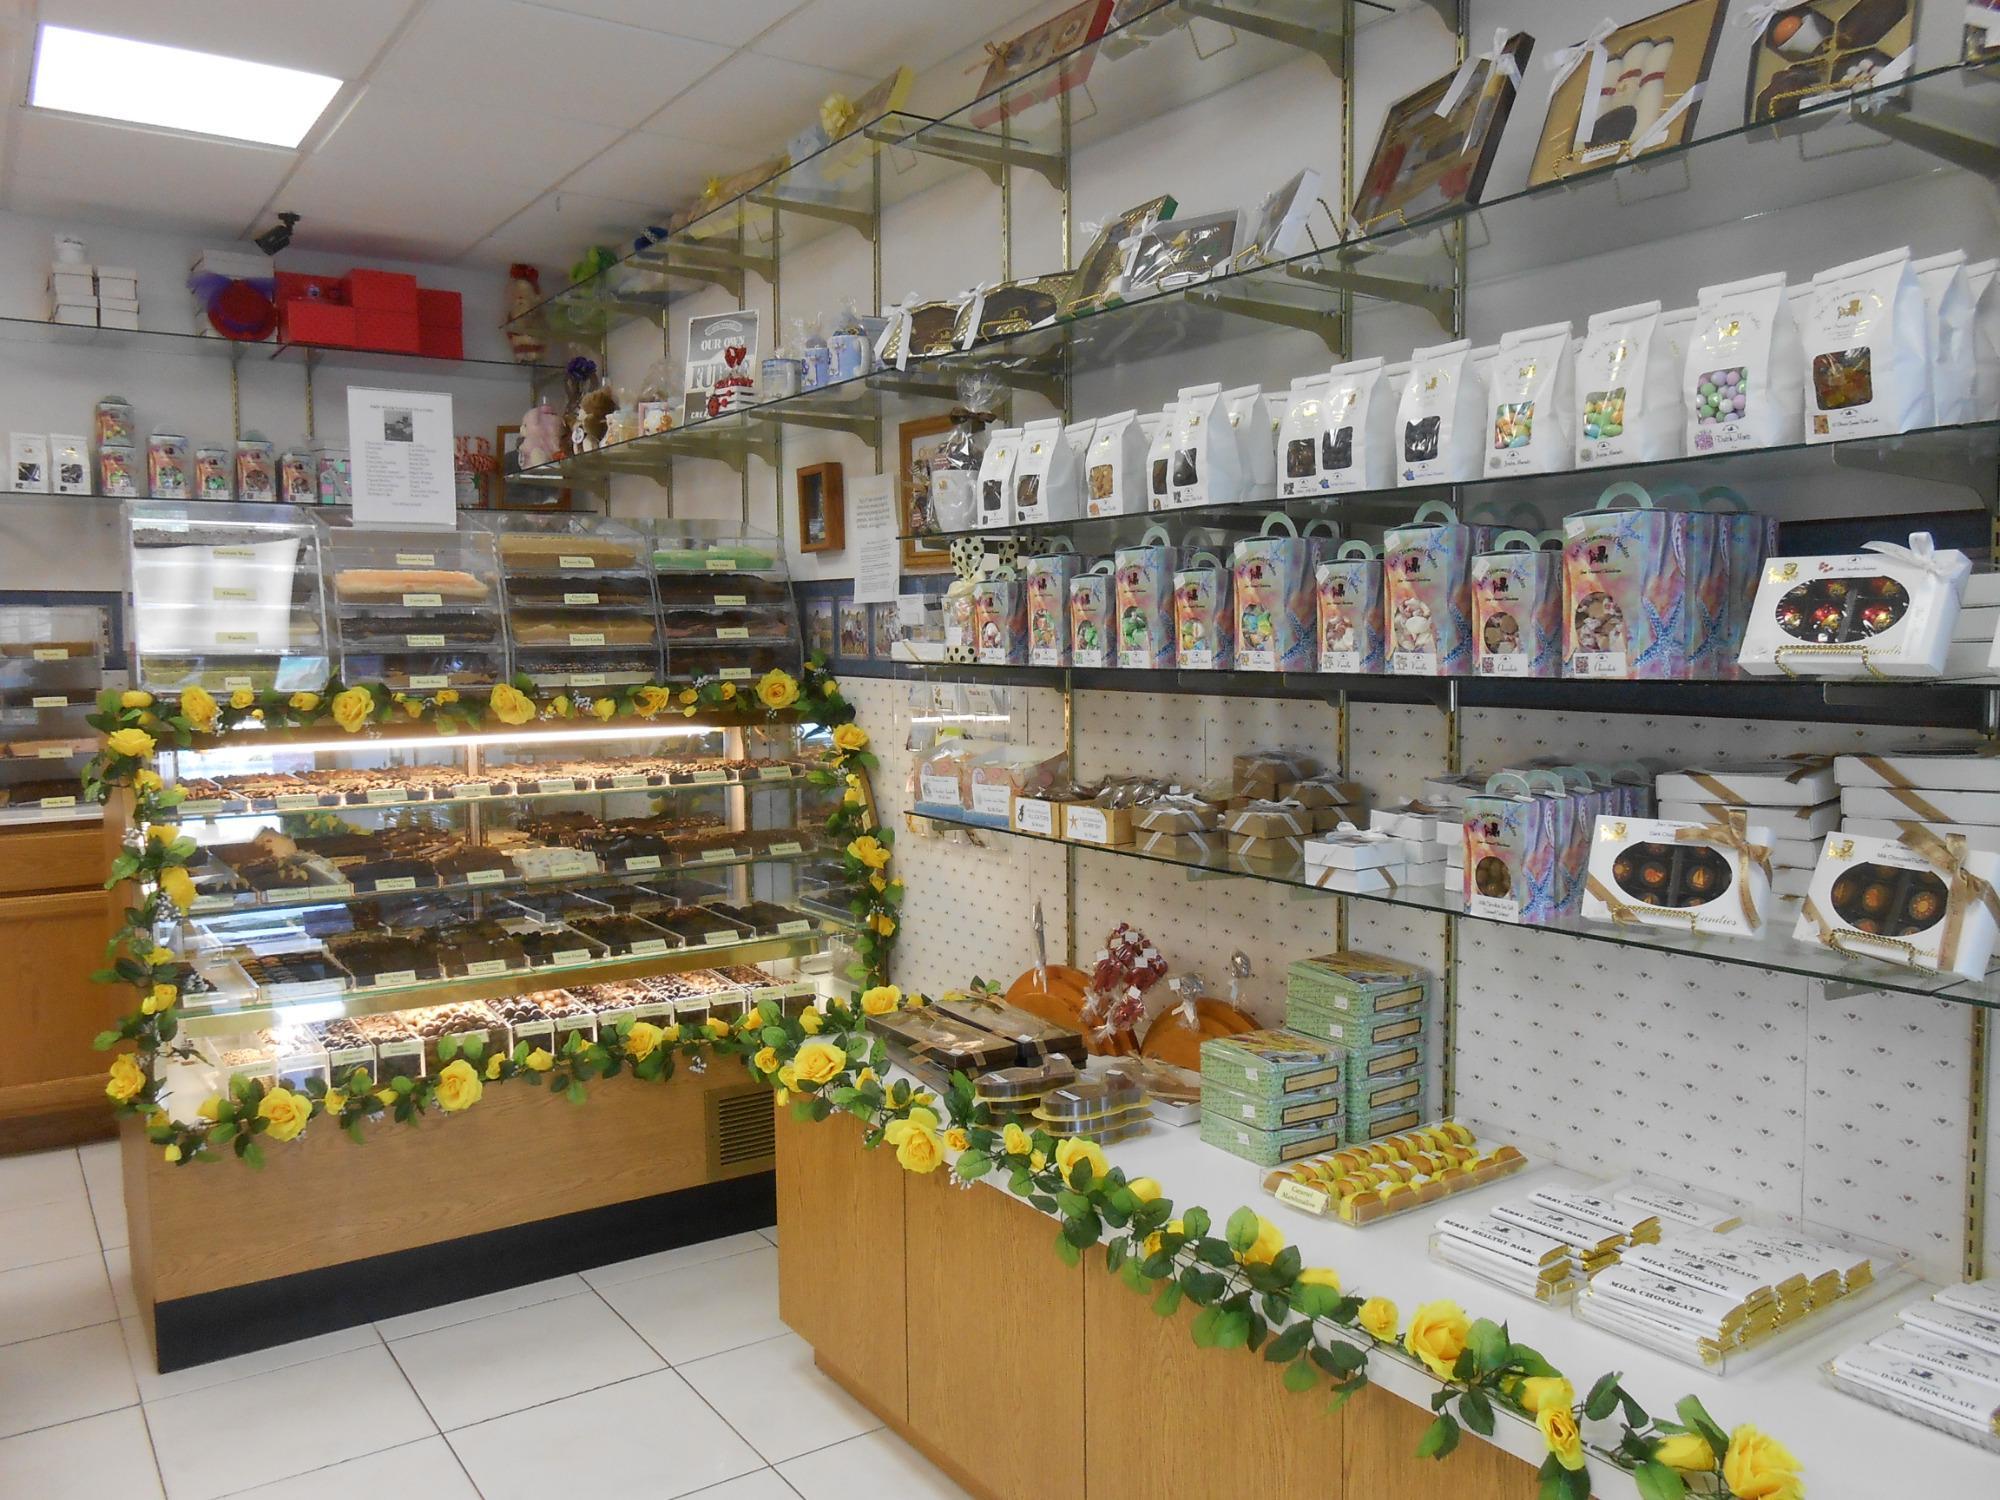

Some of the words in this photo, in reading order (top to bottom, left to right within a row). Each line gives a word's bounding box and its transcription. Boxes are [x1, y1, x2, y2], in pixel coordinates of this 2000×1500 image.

[700, 339, 721, 351] OUR
[724, 335, 745, 348] OWN
[1536, 1192, 1562, 1204] BERRY
[1563, 1201, 1601, 1218] HEALTHY
[1647, 1201, 1699, 1221] CHOCOLATE
[1444, 1218, 1470, 1232] BERRY
[1471, 1228, 1509, 1245] HEALTHY
[1498, 1207, 1525, 1219] BERRY
[1526, 1215, 1565, 1232] HEALTHY
[1673, 1248, 1698, 1260] MILK
[1699, 1257, 1761, 1281] CHOCOLATE
[1769, 1246, 1821, 1263] CHOCOLATE
[1641, 1256, 1666, 1269] MILK
[1667, 1265, 1729, 1291] CHOCOLATE
[1610, 1281, 1637, 1294] MILK
[1639, 1290, 1704, 1315] CHOCOLATE
[1979, 1304, 2000, 1314] DAR
[1944, 1322, 1973, 1336] DARK
[1917, 1353, 1945, 1366] DARK
[1880, 1372, 1909, 1389] DARK
[1911, 1382, 1978, 1410] CHOCOLATE
